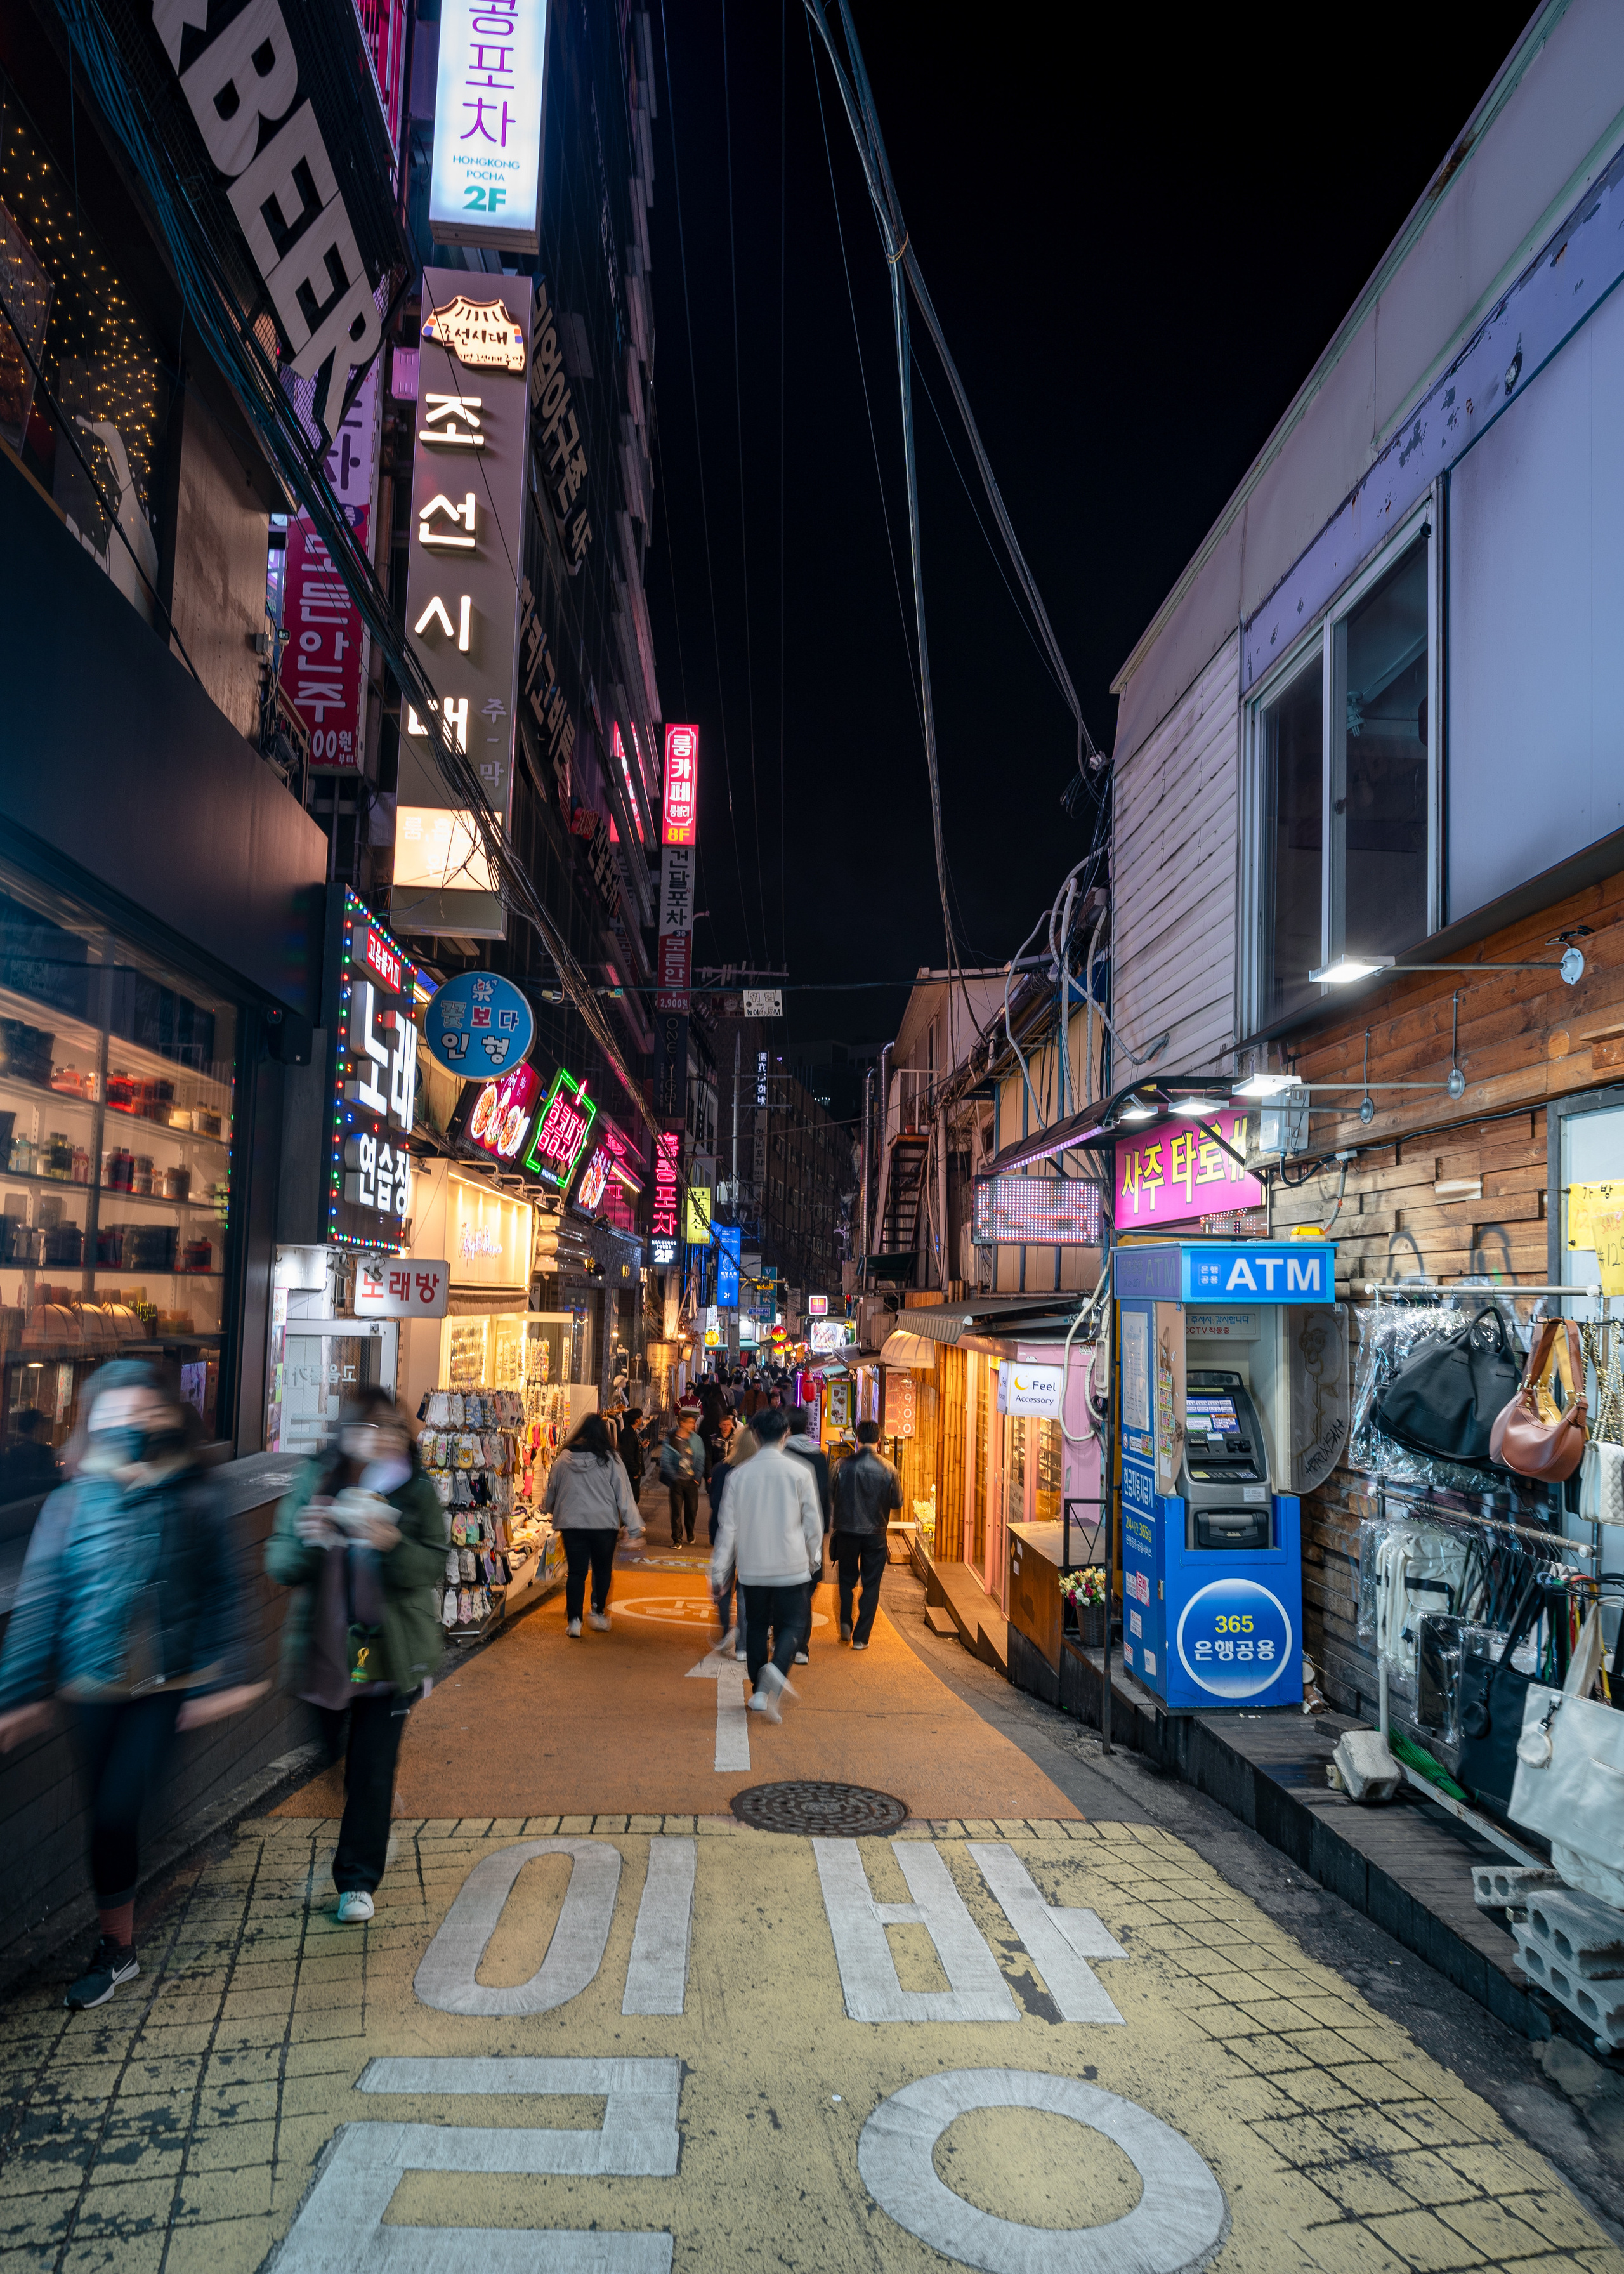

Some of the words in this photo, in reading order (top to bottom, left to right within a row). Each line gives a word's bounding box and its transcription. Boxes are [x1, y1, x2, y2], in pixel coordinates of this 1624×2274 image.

[453, 155, 520, 169] HONGKONG
[466, 170, 505, 181] POCHA
[462, 185, 507, 213] 2F
[442, 323, 508, 346] 조선시대
[669, 735, 692, 802] 룸카페
[668, 827, 690, 842] 8F
[666, 850, 690, 927] 건달포차
[750, 992, 775, 1002] 위험
[359, 980, 417, 1132] 노래
[441, 1032, 511, 1065] 인형
[359, 1132, 410, 1216] 연습장
[1120, 1140, 1165, 1214] 사주
[1171, 1119, 1226, 1204] 타로
[652, 1132, 679, 1236] 홍콩포차
[1583, 1185, 1613, 1199] 가방
[654, 1249, 674, 1263] 2F
[1144, 1256, 1176, 1287] ATM
[1201, 1266, 1219, 1274] 은행
[1201, 1275, 1219, 1284] 공용
[1225, 1258, 1321, 1291] ATM
[361, 1271, 440, 1304] 노래방
[1215, 1315, 1249, 1325] 감사합니다
[1032, 1380, 1056, 1391] Feel
[1015, 1395, 1054, 1406] Accessory
[1123, 1466, 1153, 1508] 현금자동지급기
[1215, 1615, 1254, 1633] 365
[1194, 1640, 1276, 1661] 은행공용
